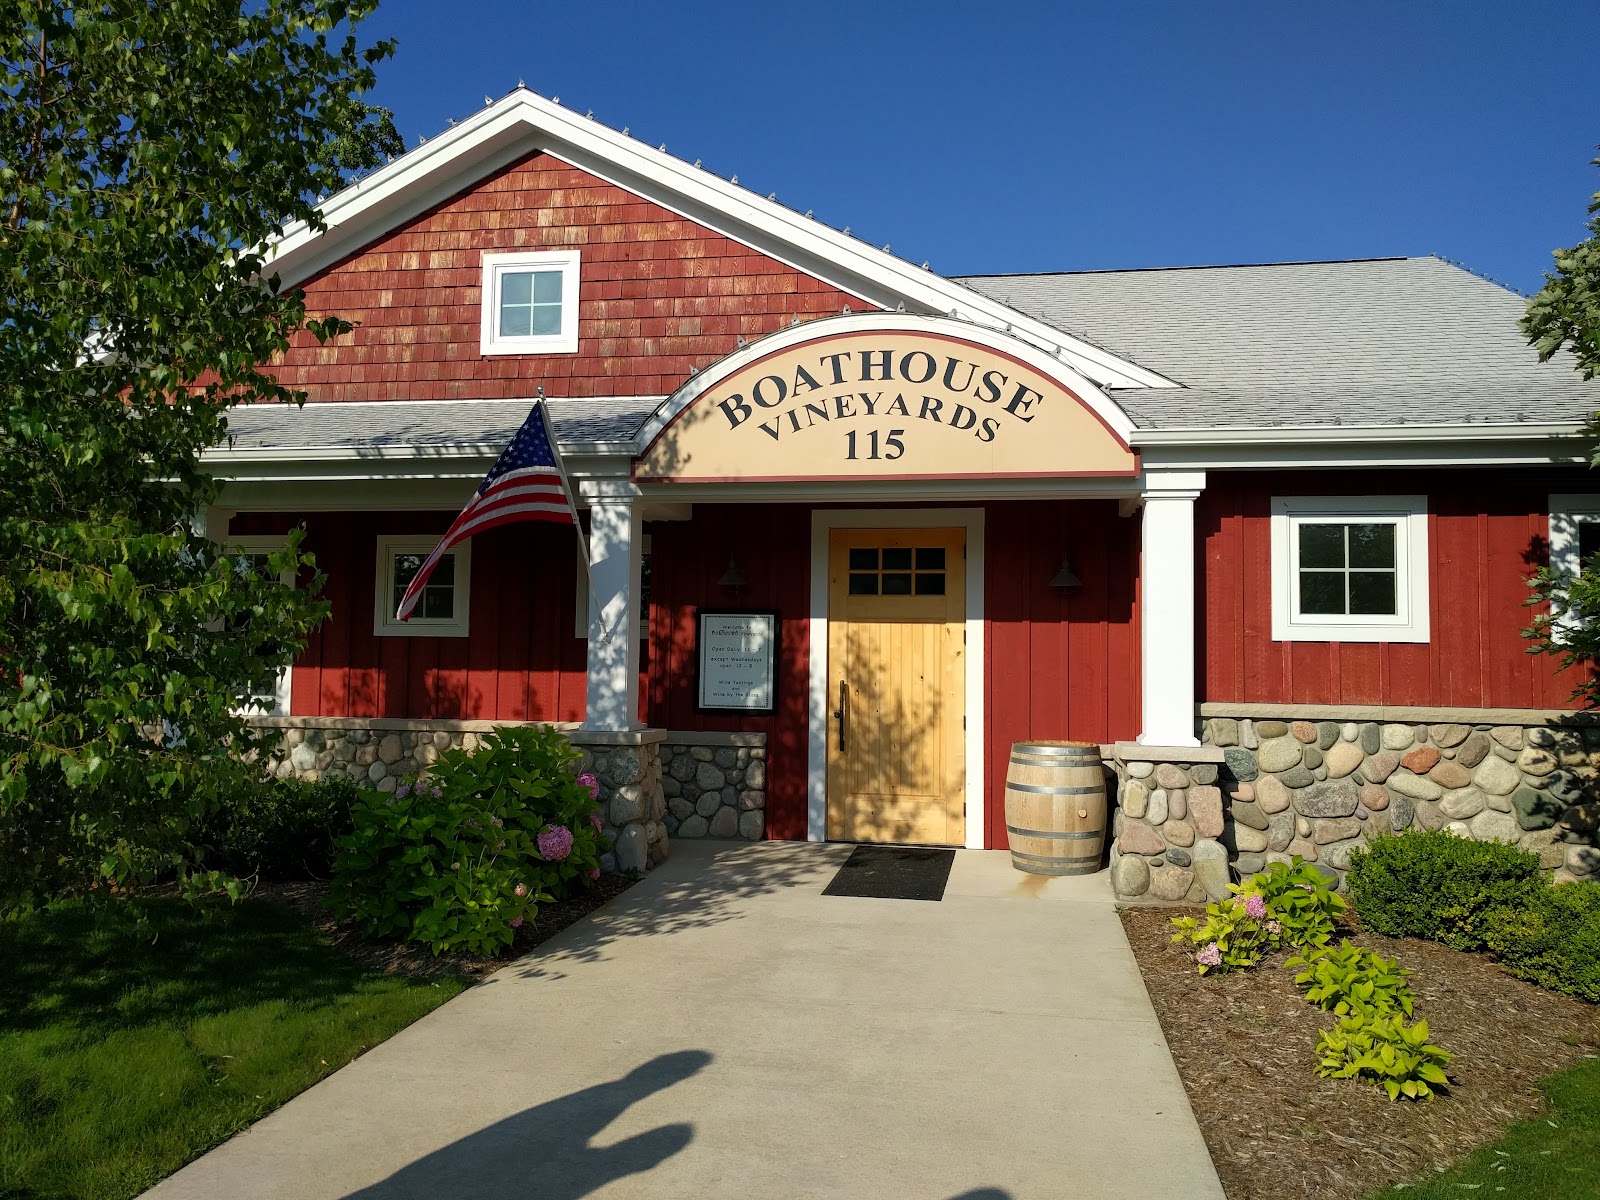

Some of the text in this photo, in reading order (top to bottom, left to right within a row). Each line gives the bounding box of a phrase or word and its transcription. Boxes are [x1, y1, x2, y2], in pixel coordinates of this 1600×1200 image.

[716, 350, 1044, 431] BOATHOUSE
[757, 392, 1001, 442] VINEYARDS
[844, 430, 905, 460] 115
